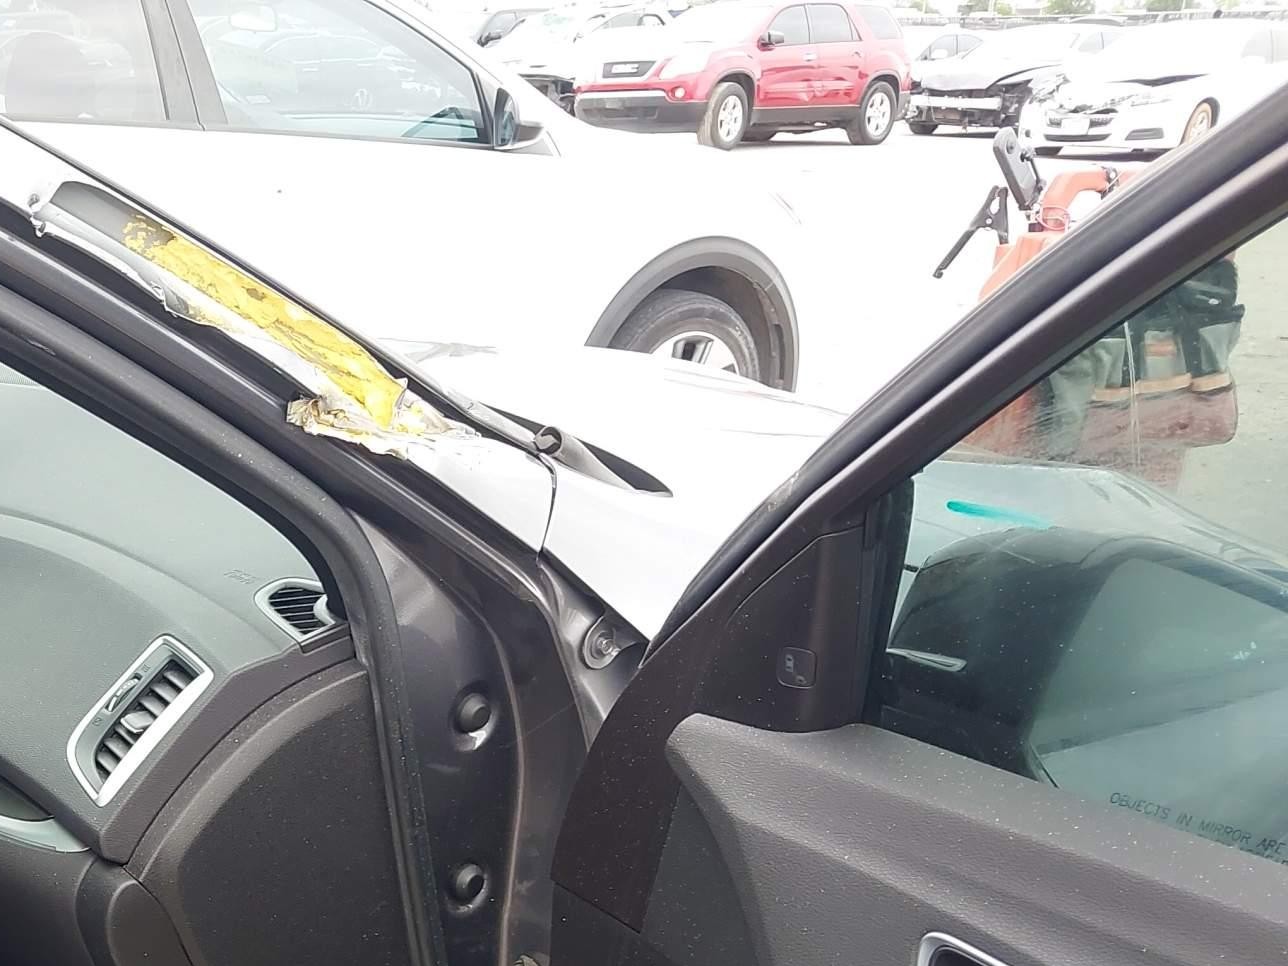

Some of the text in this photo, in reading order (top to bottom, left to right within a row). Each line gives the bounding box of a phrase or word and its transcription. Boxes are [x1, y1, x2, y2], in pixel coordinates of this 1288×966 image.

[1110, 792, 1287, 855] OBJECTS IN MIRROR ARE
